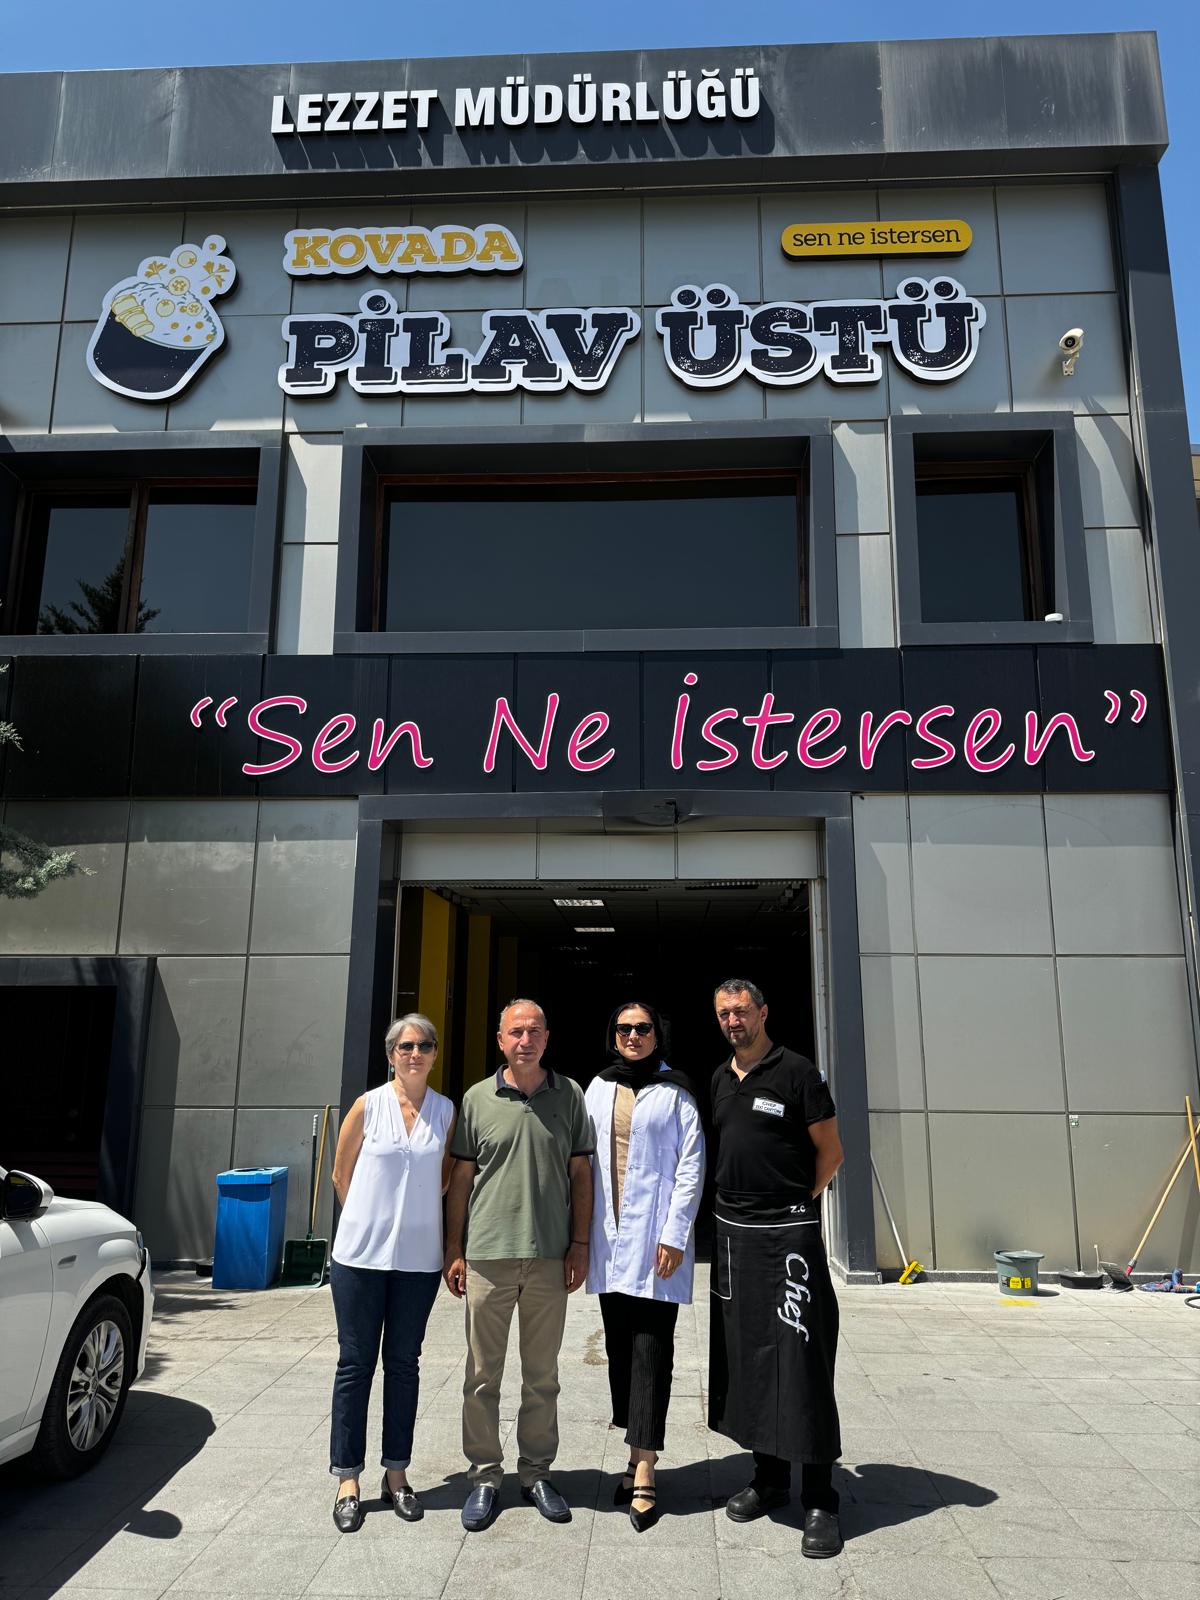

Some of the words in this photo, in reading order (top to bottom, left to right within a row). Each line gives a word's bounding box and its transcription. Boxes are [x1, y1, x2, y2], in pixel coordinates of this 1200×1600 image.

[270, 88, 439, 134] LEZZET
[453, 67, 762, 128] MÜDÜRLÜĞÜ
[291, 231, 518, 268] KOVADA
[792, 231, 833, 247] sen
[837, 231, 865, 246] ne
[870, 228, 961, 246] istersen
[285, 293, 637, 388] PİLAV
[661, 281, 979, 379] ÜSTÜ
[483, 693, 616, 772] Ne
[777, 1252, 811, 1342] Chef
